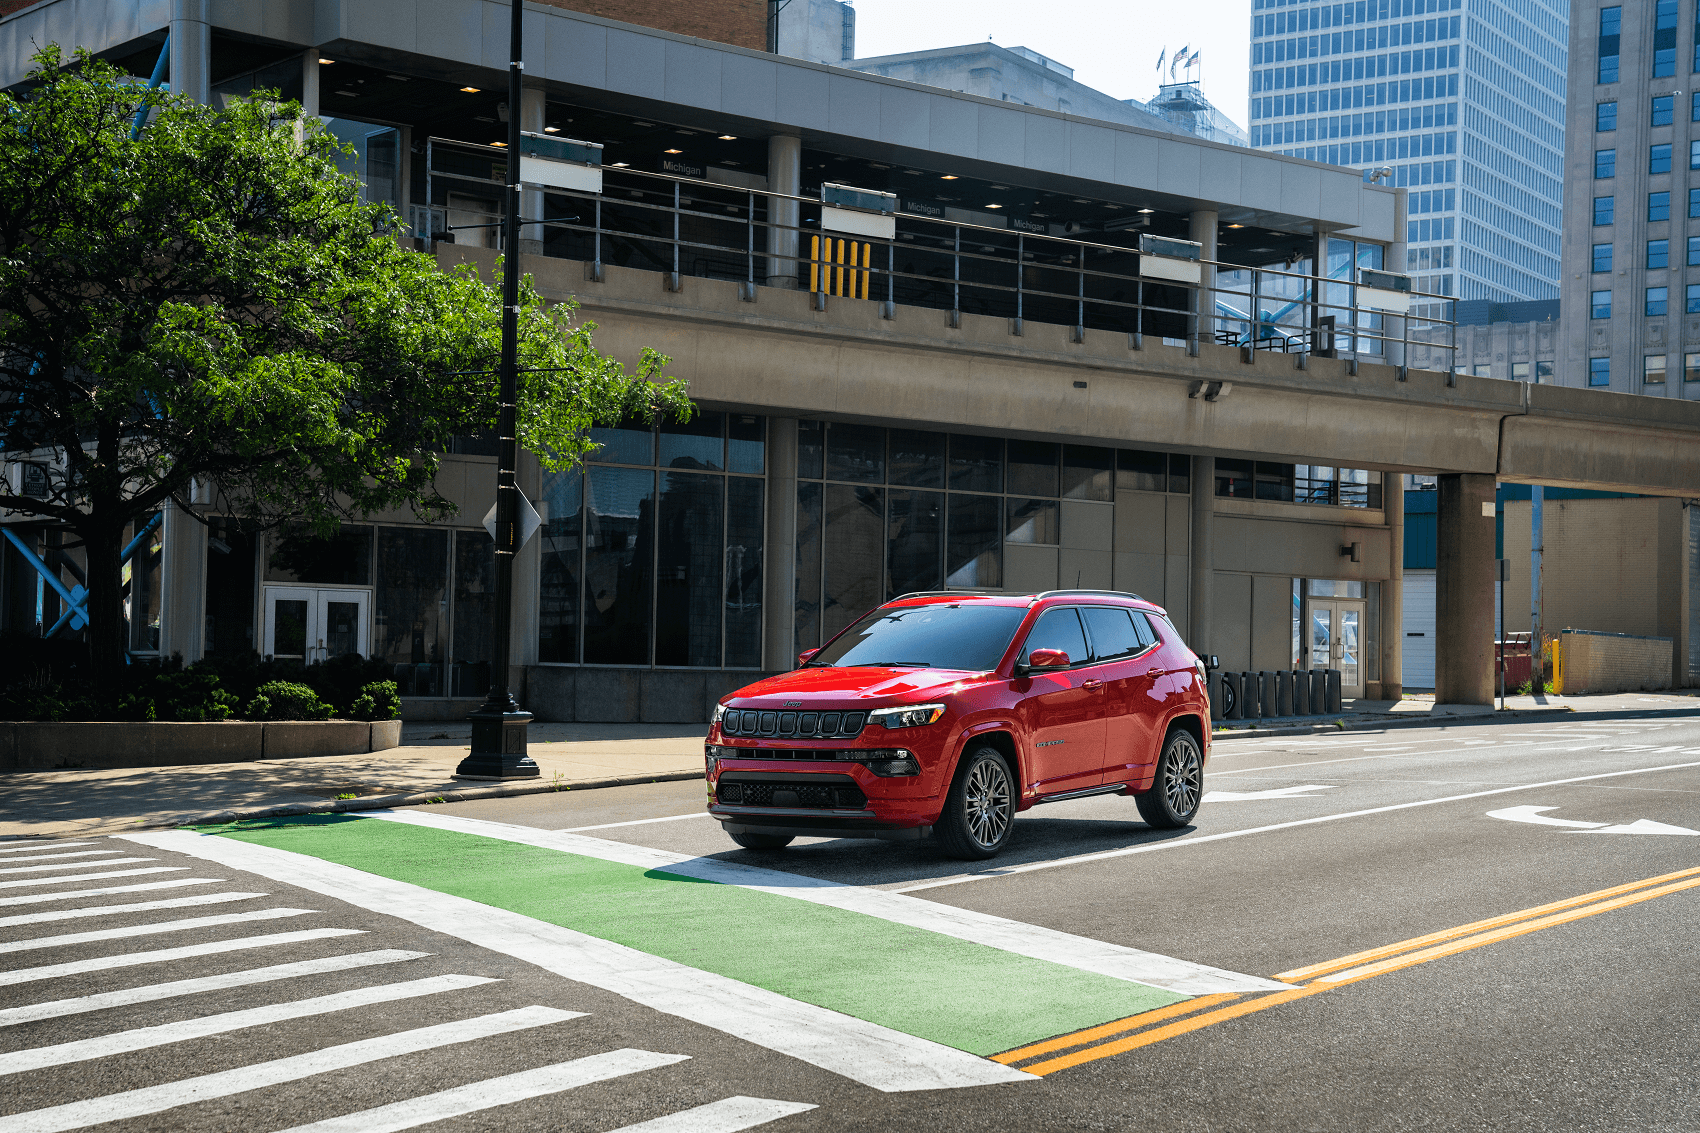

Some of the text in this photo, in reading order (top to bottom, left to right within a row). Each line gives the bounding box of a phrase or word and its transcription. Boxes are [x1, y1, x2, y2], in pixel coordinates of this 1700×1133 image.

[663, 160, 701, 175] Michigan
[907, 201, 941, 215] Michigan
[1013, 218, 1045, 232] Michigan
